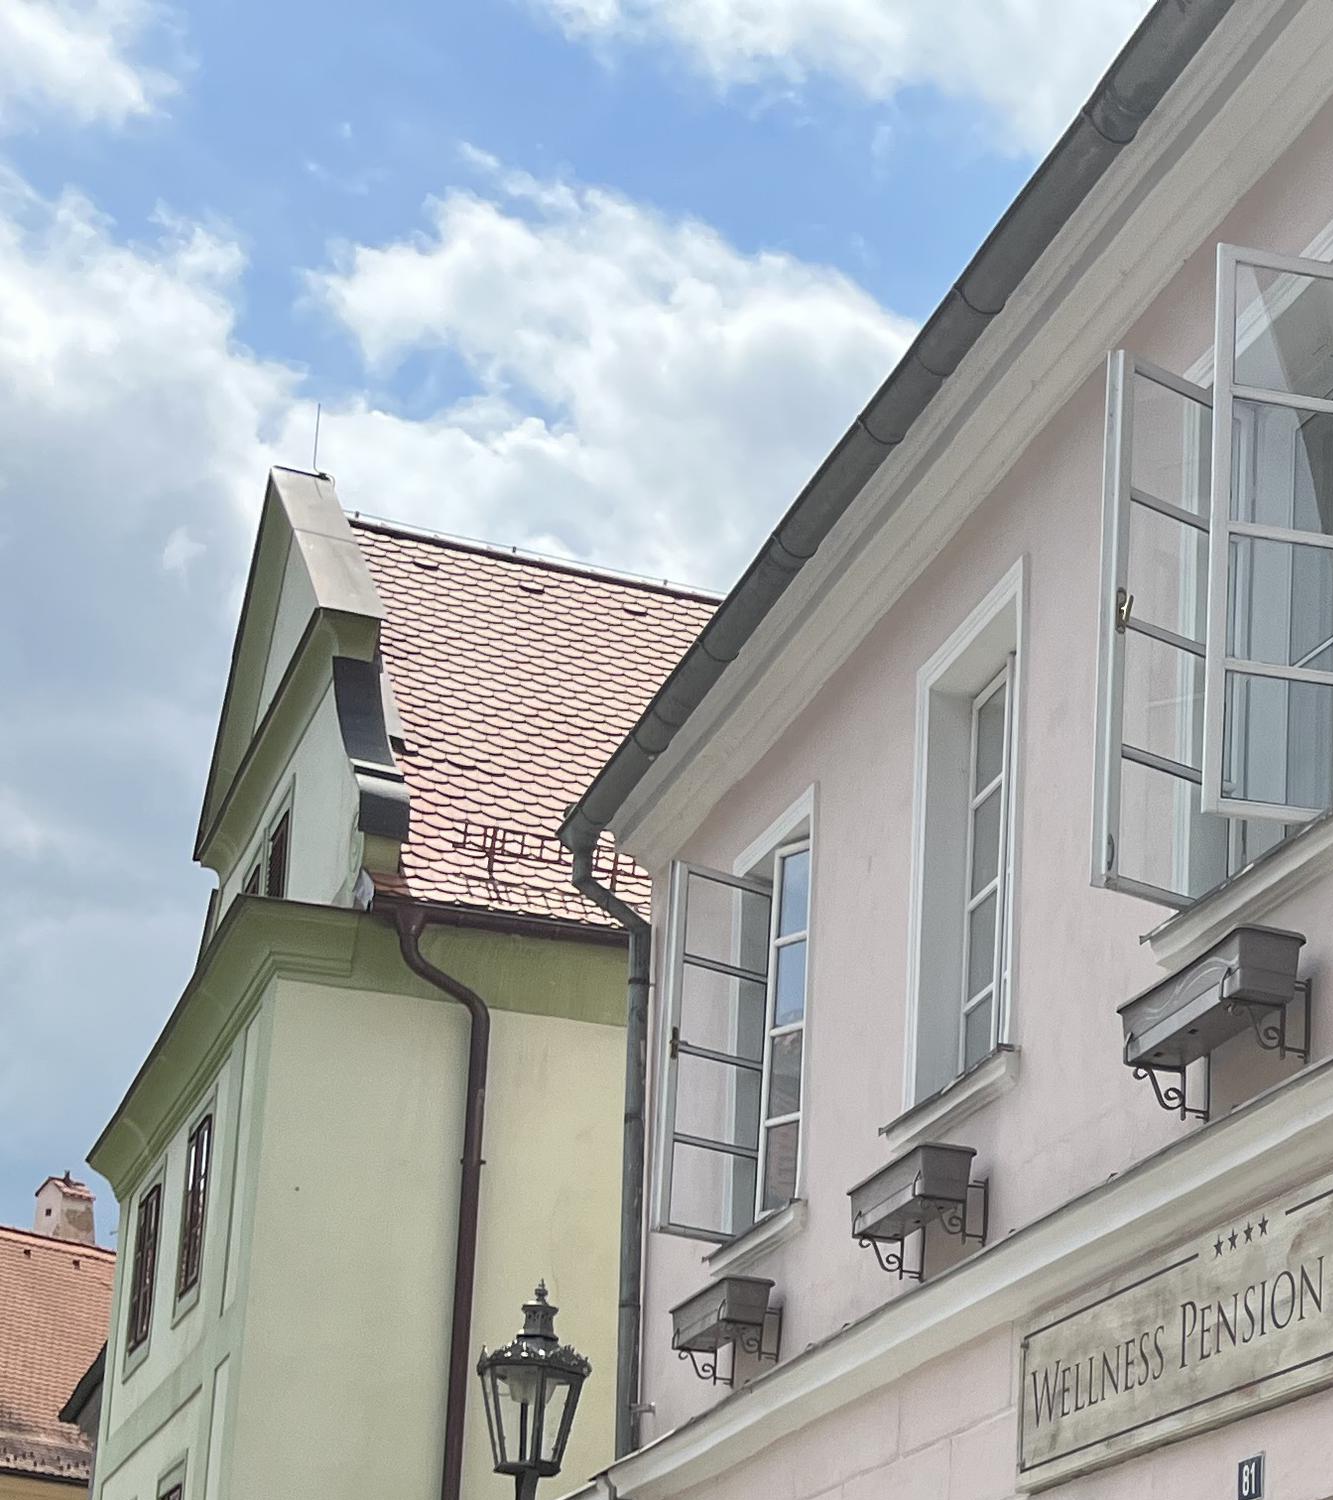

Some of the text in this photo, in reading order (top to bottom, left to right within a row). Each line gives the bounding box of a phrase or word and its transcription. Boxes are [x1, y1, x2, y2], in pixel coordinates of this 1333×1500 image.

[1030, 1325, 1164, 1428] WELLNESS
[1178, 1255, 1327, 1369] PENSION
[1242, 1461, 1256, 1497] 81
